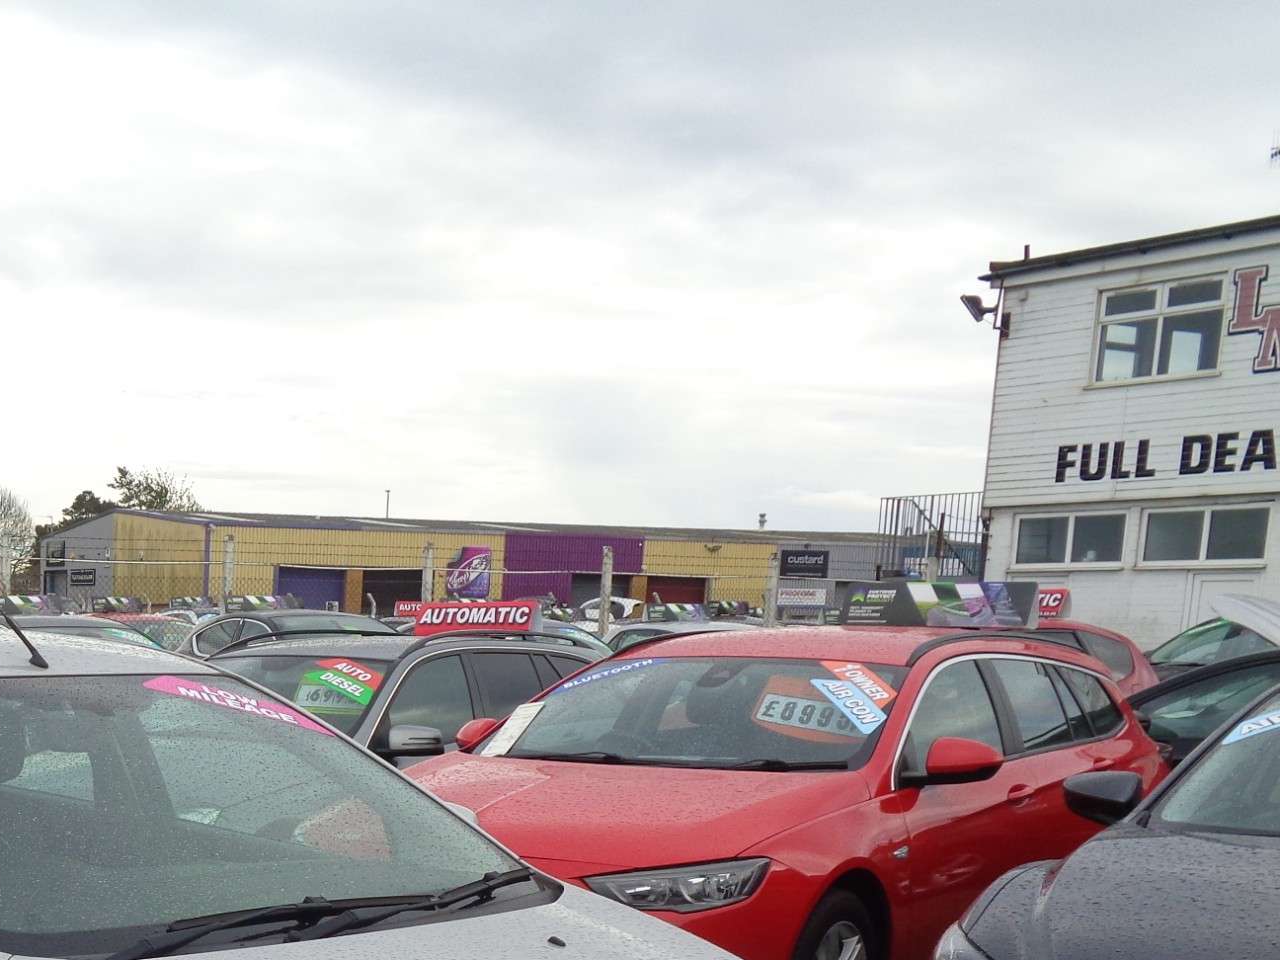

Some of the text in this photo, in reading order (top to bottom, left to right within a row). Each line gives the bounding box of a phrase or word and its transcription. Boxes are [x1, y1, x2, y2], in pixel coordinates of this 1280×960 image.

[1055, 429, 1278, 483] FULL DEA
[787, 555, 824, 564] custard
[419, 606, 530, 625] AUTOMATIC
[320, 672, 365, 697] DIESEL
[334, 662, 372, 681] AUTO
[563, 658, 653, 689] BLUETOOTH
[845, 670, 890, 701] OWNER
[177, 685, 298, 725] MILEAGE
[201, 685, 259, 706] LOW
[821, 681, 881, 725] AIR CON
